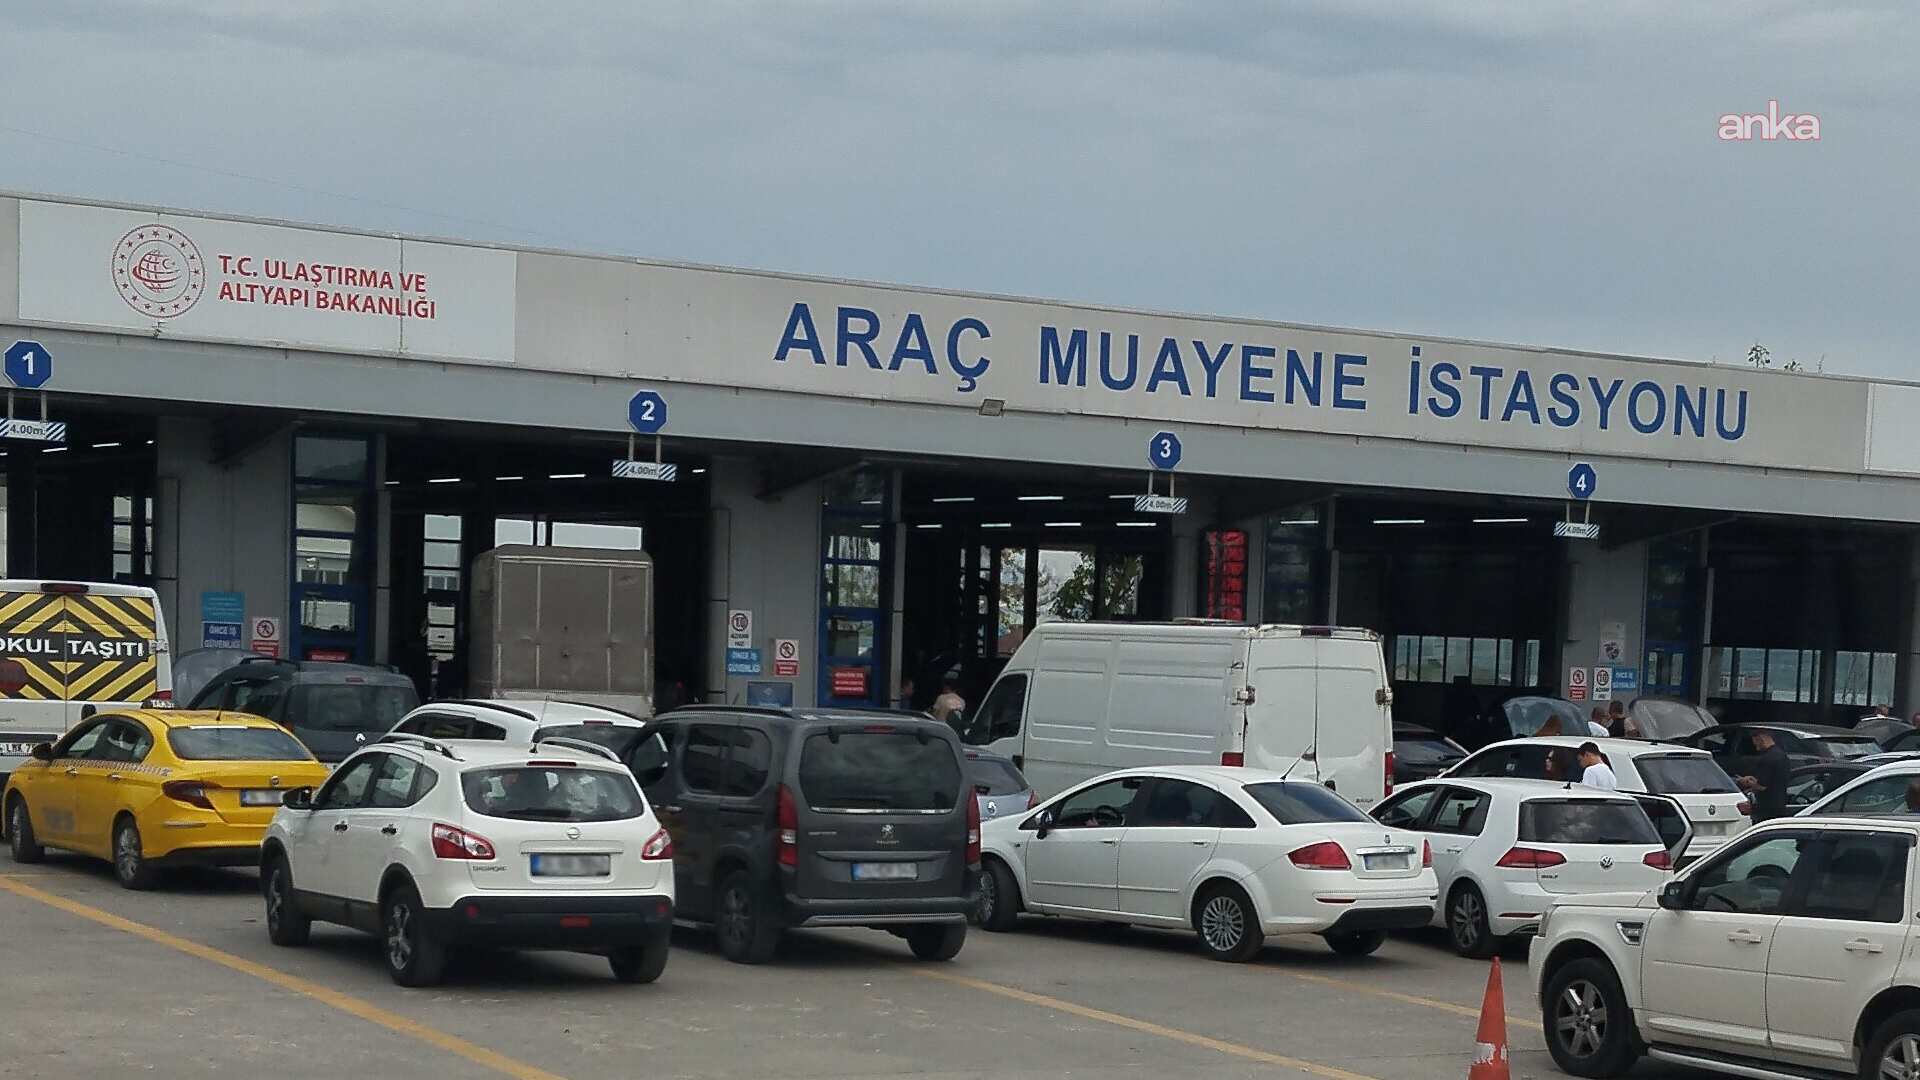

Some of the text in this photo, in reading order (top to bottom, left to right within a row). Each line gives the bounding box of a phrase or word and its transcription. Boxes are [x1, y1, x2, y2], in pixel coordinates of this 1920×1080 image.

[217, 254, 427, 293] T.C. ULAŞTIRMA VE
[218, 281, 436, 319] ALTYAPI BAKANLIĞI
[22, 351, 34, 375] 1
[776, 303, 1747, 440] ARAÇ MUAYENE İSTASYONU
[641, 400, 655, 421] 2
[1160, 439, 1171, 458] 3
[1576, 473, 1587, 491] 4
[67, 640, 144, 659] TAŞITI
